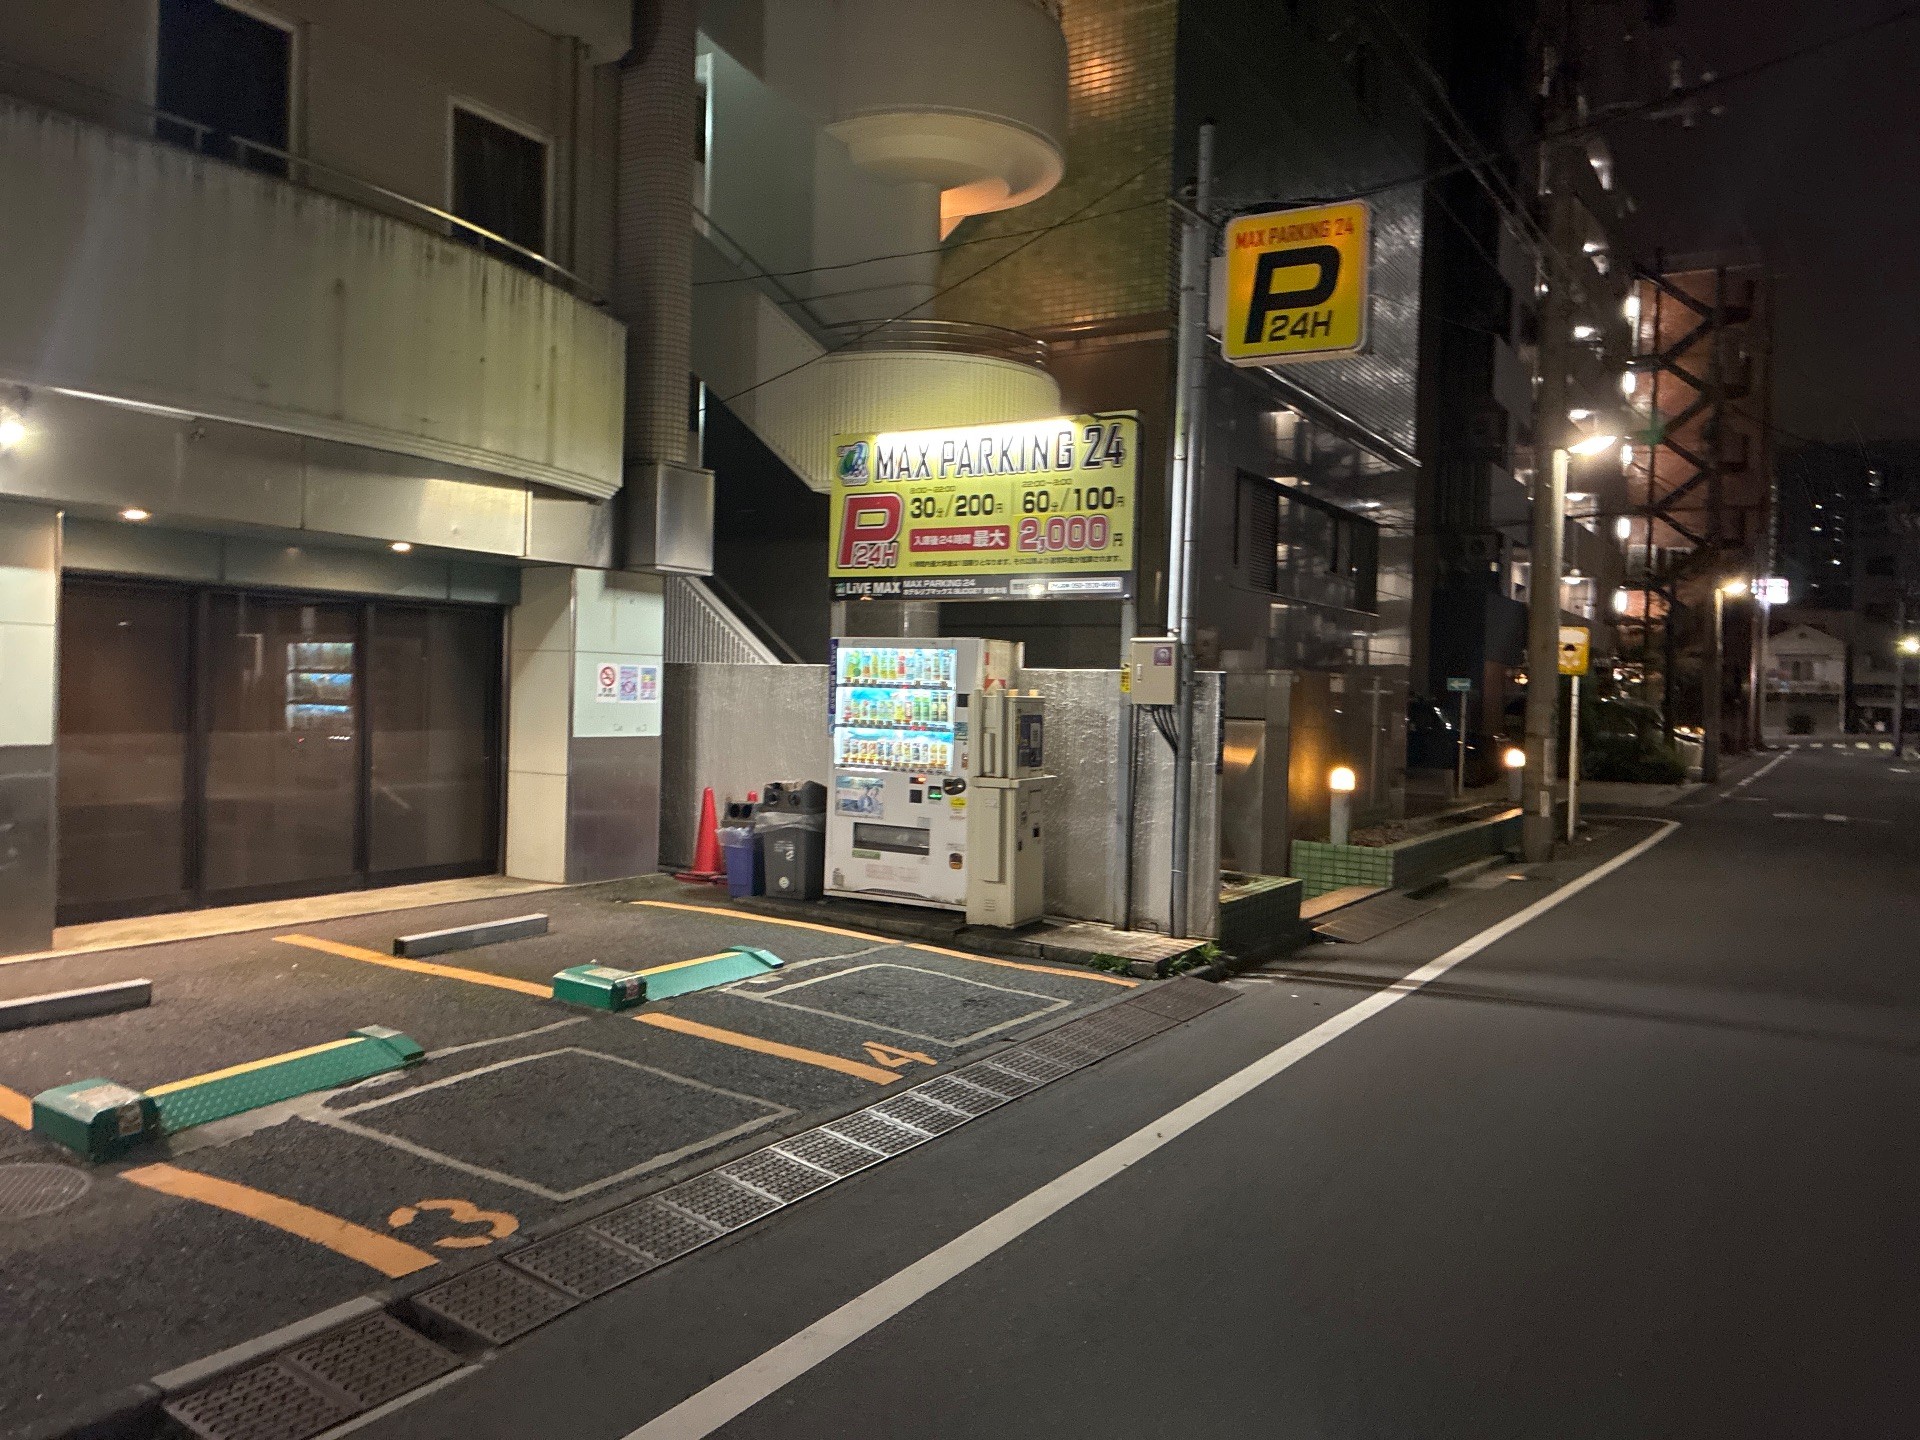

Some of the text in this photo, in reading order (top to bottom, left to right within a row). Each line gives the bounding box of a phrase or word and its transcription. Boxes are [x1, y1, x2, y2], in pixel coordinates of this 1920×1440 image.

[1236, 217, 1354, 248] MAX PARKING 24
[1244, 245, 1341, 344] P
[1268, 310, 1333, 342] 24H
[874, 423, 1124, 483] MAX PARKING 24
[838, 492, 904, 568] P
[972, 529, 1006, 548] 最大
[853, 541, 899, 568] 24H
[873, 581, 901, 594] MAX
[903, 579, 976, 588] MAX PARKING 24
[861, 1041, 938, 1066] 4
[387, 1199, 520, 1248] 3
